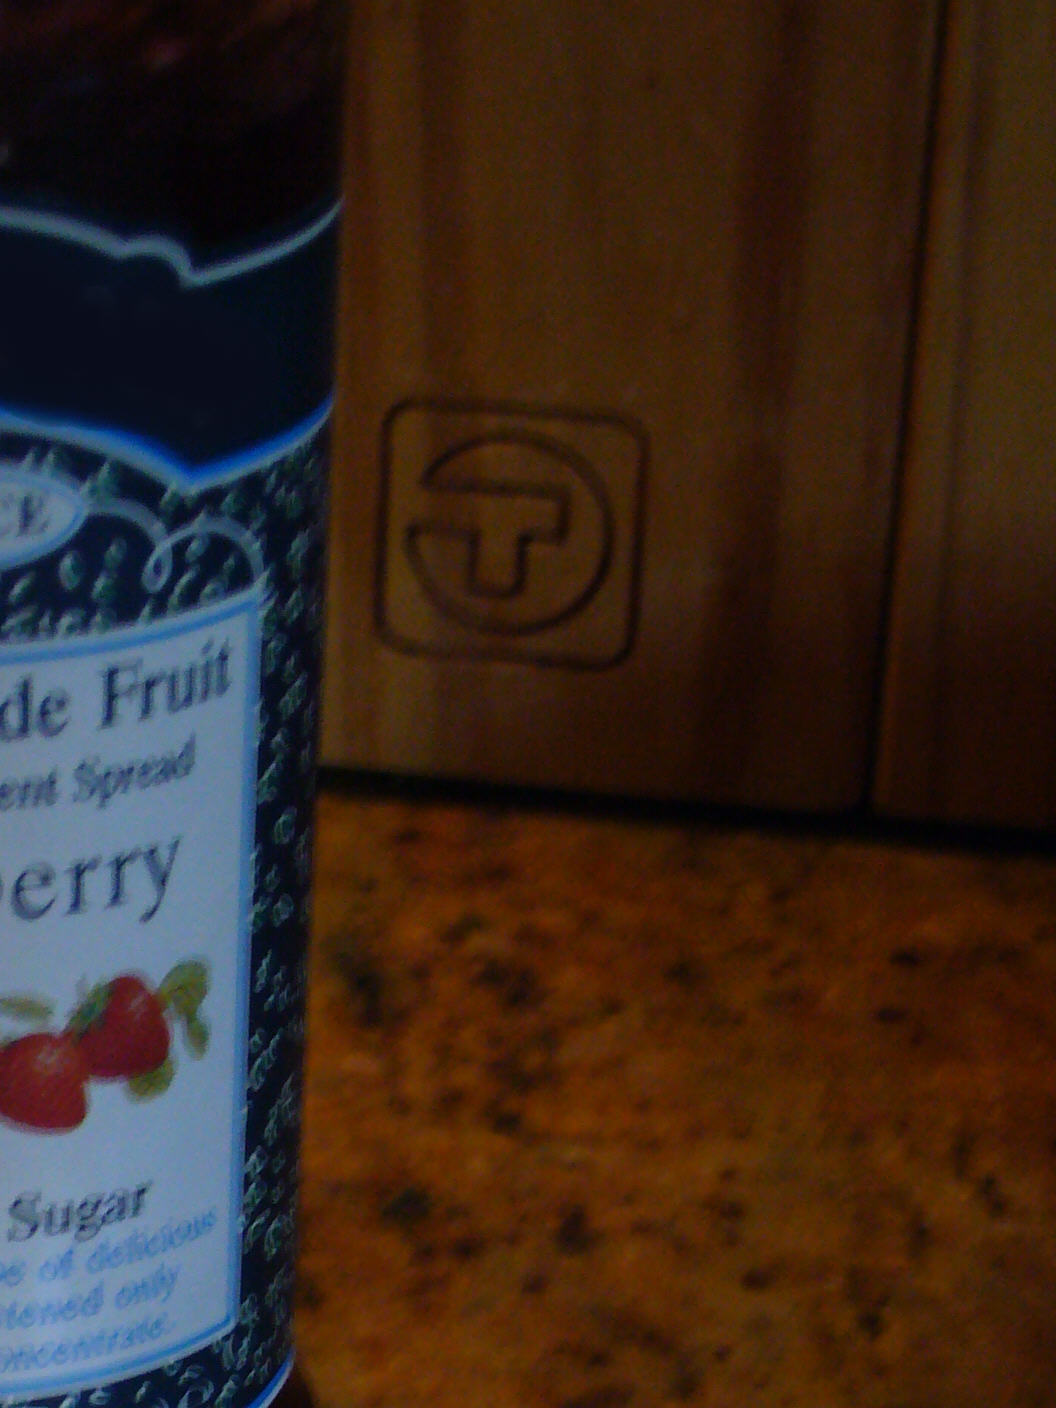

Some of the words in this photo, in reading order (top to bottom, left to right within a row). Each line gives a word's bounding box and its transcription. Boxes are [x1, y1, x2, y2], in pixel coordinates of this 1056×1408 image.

[97, 636, 231, 730] Fruit
[70, 730, 198, 811] Spread
[6, 1178, 154, 1244] Sugar
[39, 1246, 77, 1281] of
